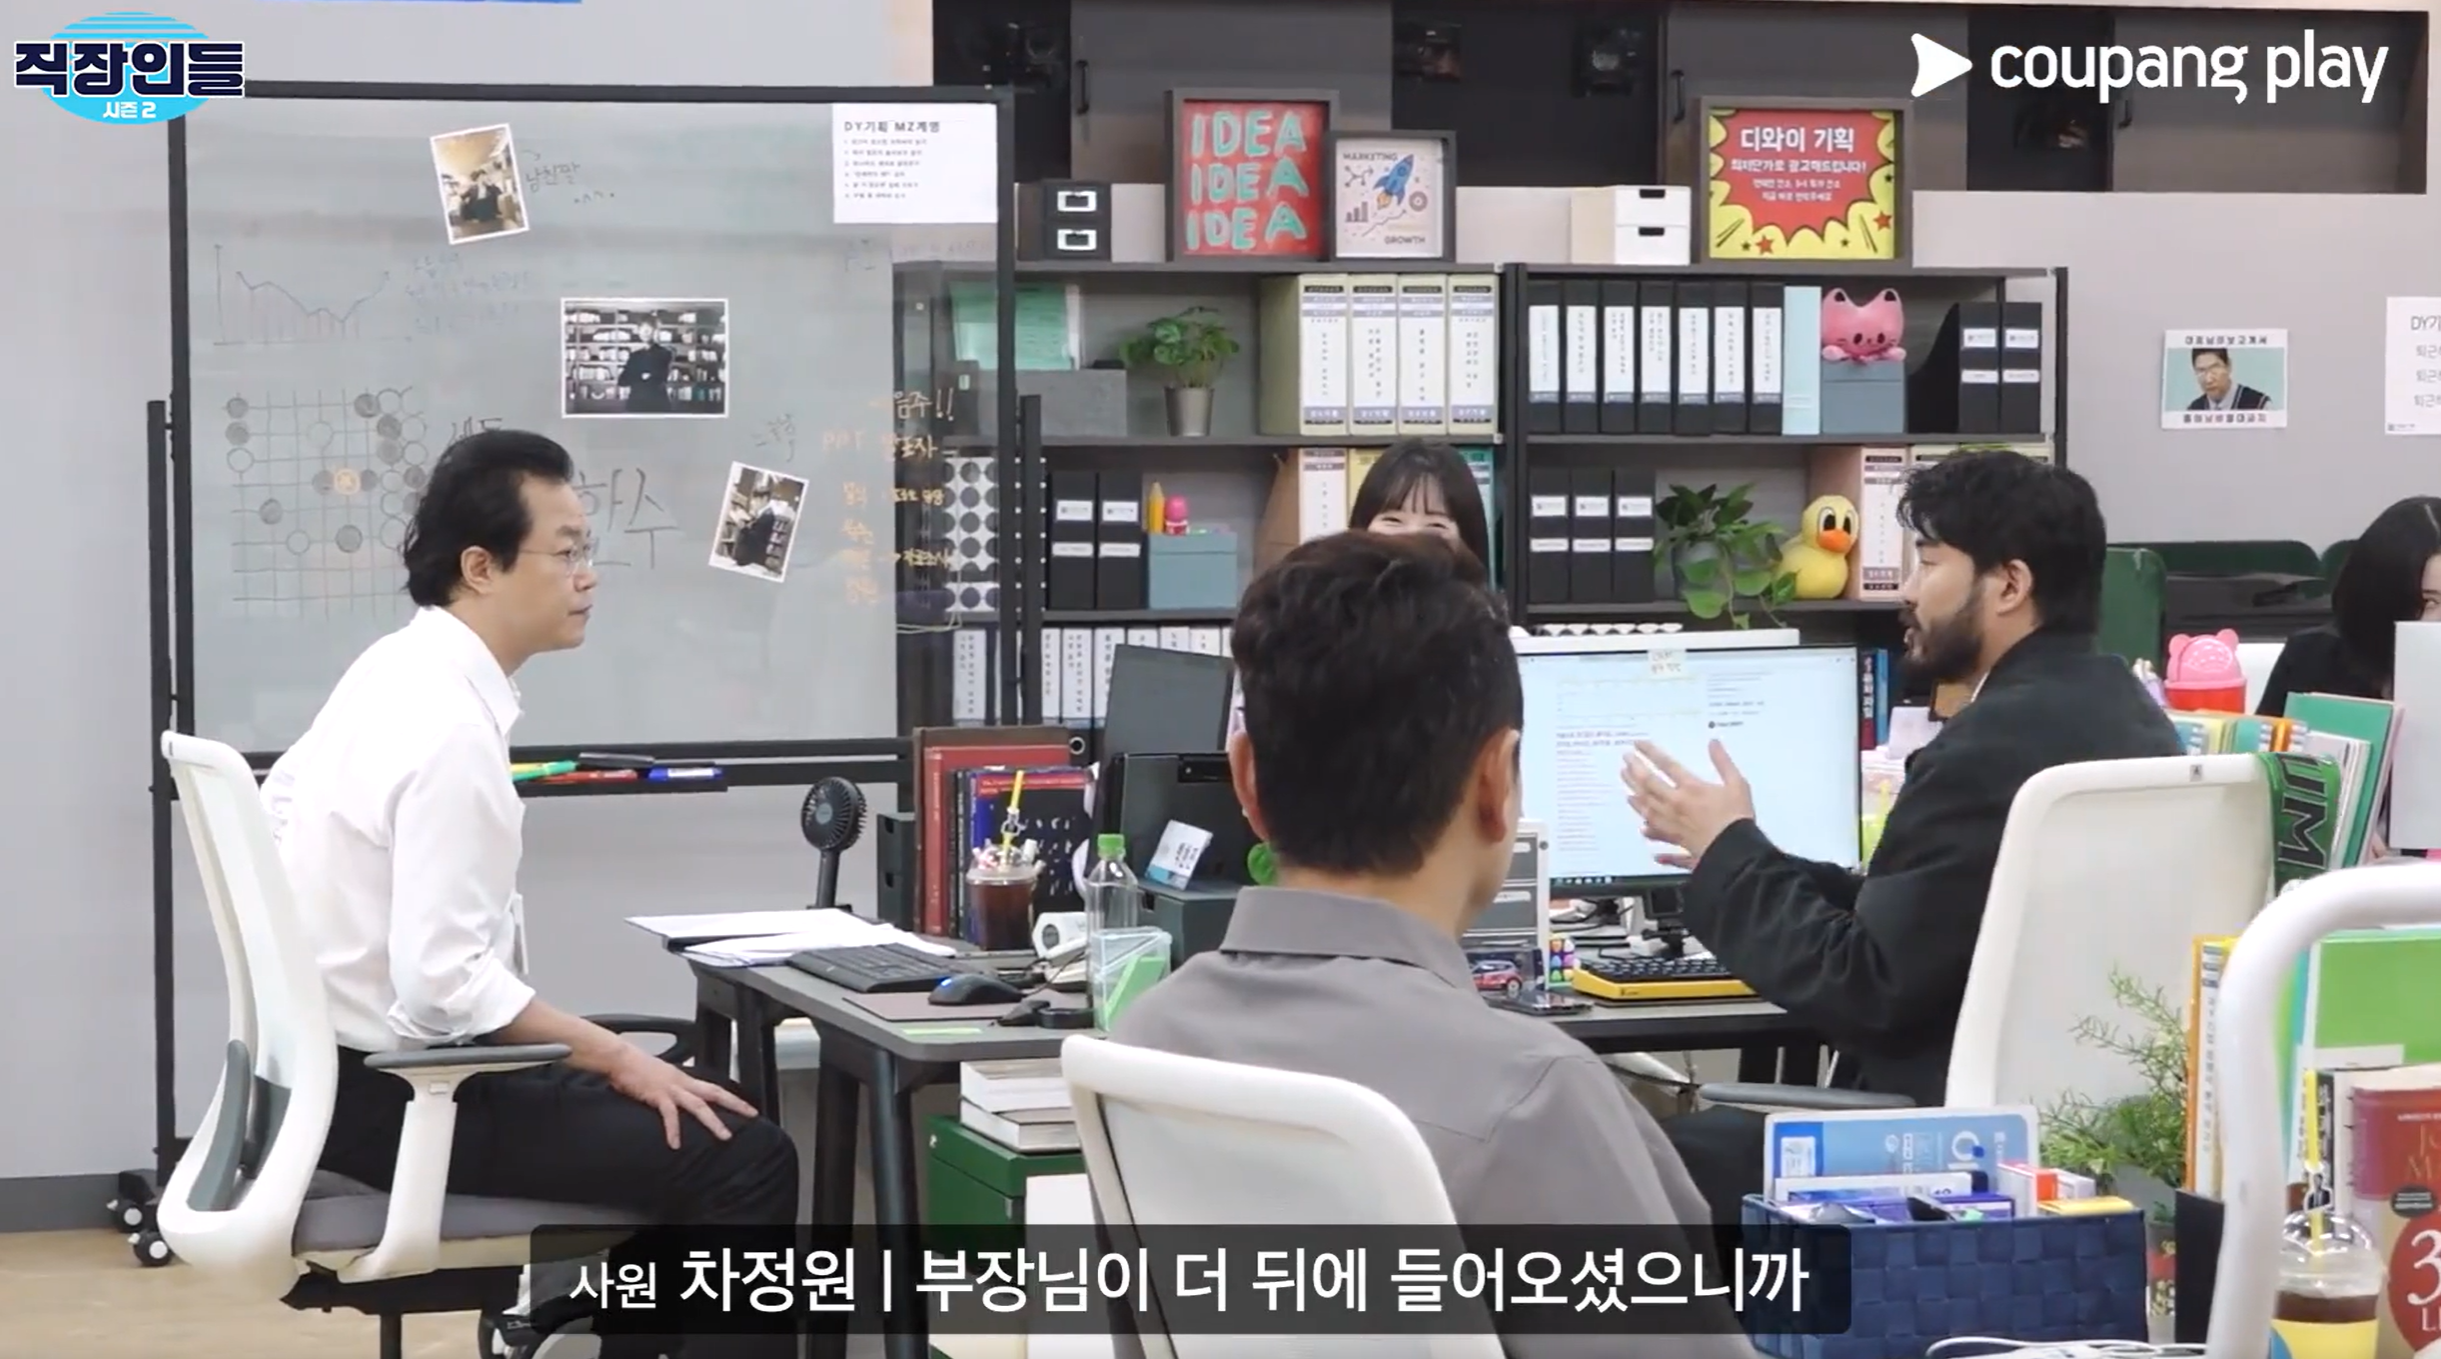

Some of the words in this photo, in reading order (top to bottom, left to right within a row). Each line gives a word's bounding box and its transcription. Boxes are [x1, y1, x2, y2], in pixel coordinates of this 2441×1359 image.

[1192, 110, 1307, 158] IDEA
[1740, 127, 1806, 153] 디와이
[1813, 127, 1855, 153] 기획
[1342, 152, 1399, 162] MARKETING
[1190, 155, 1310, 205] IDEA
[1186, 201, 1308, 250] IDEA
[1384, 236, 1426, 246] GROWTH
[2416, 344, 2441, 359] 퇴근
[2416, 368, 2441, 383] 퇴근
[2413, 393, 2441, 408] 퇴근
